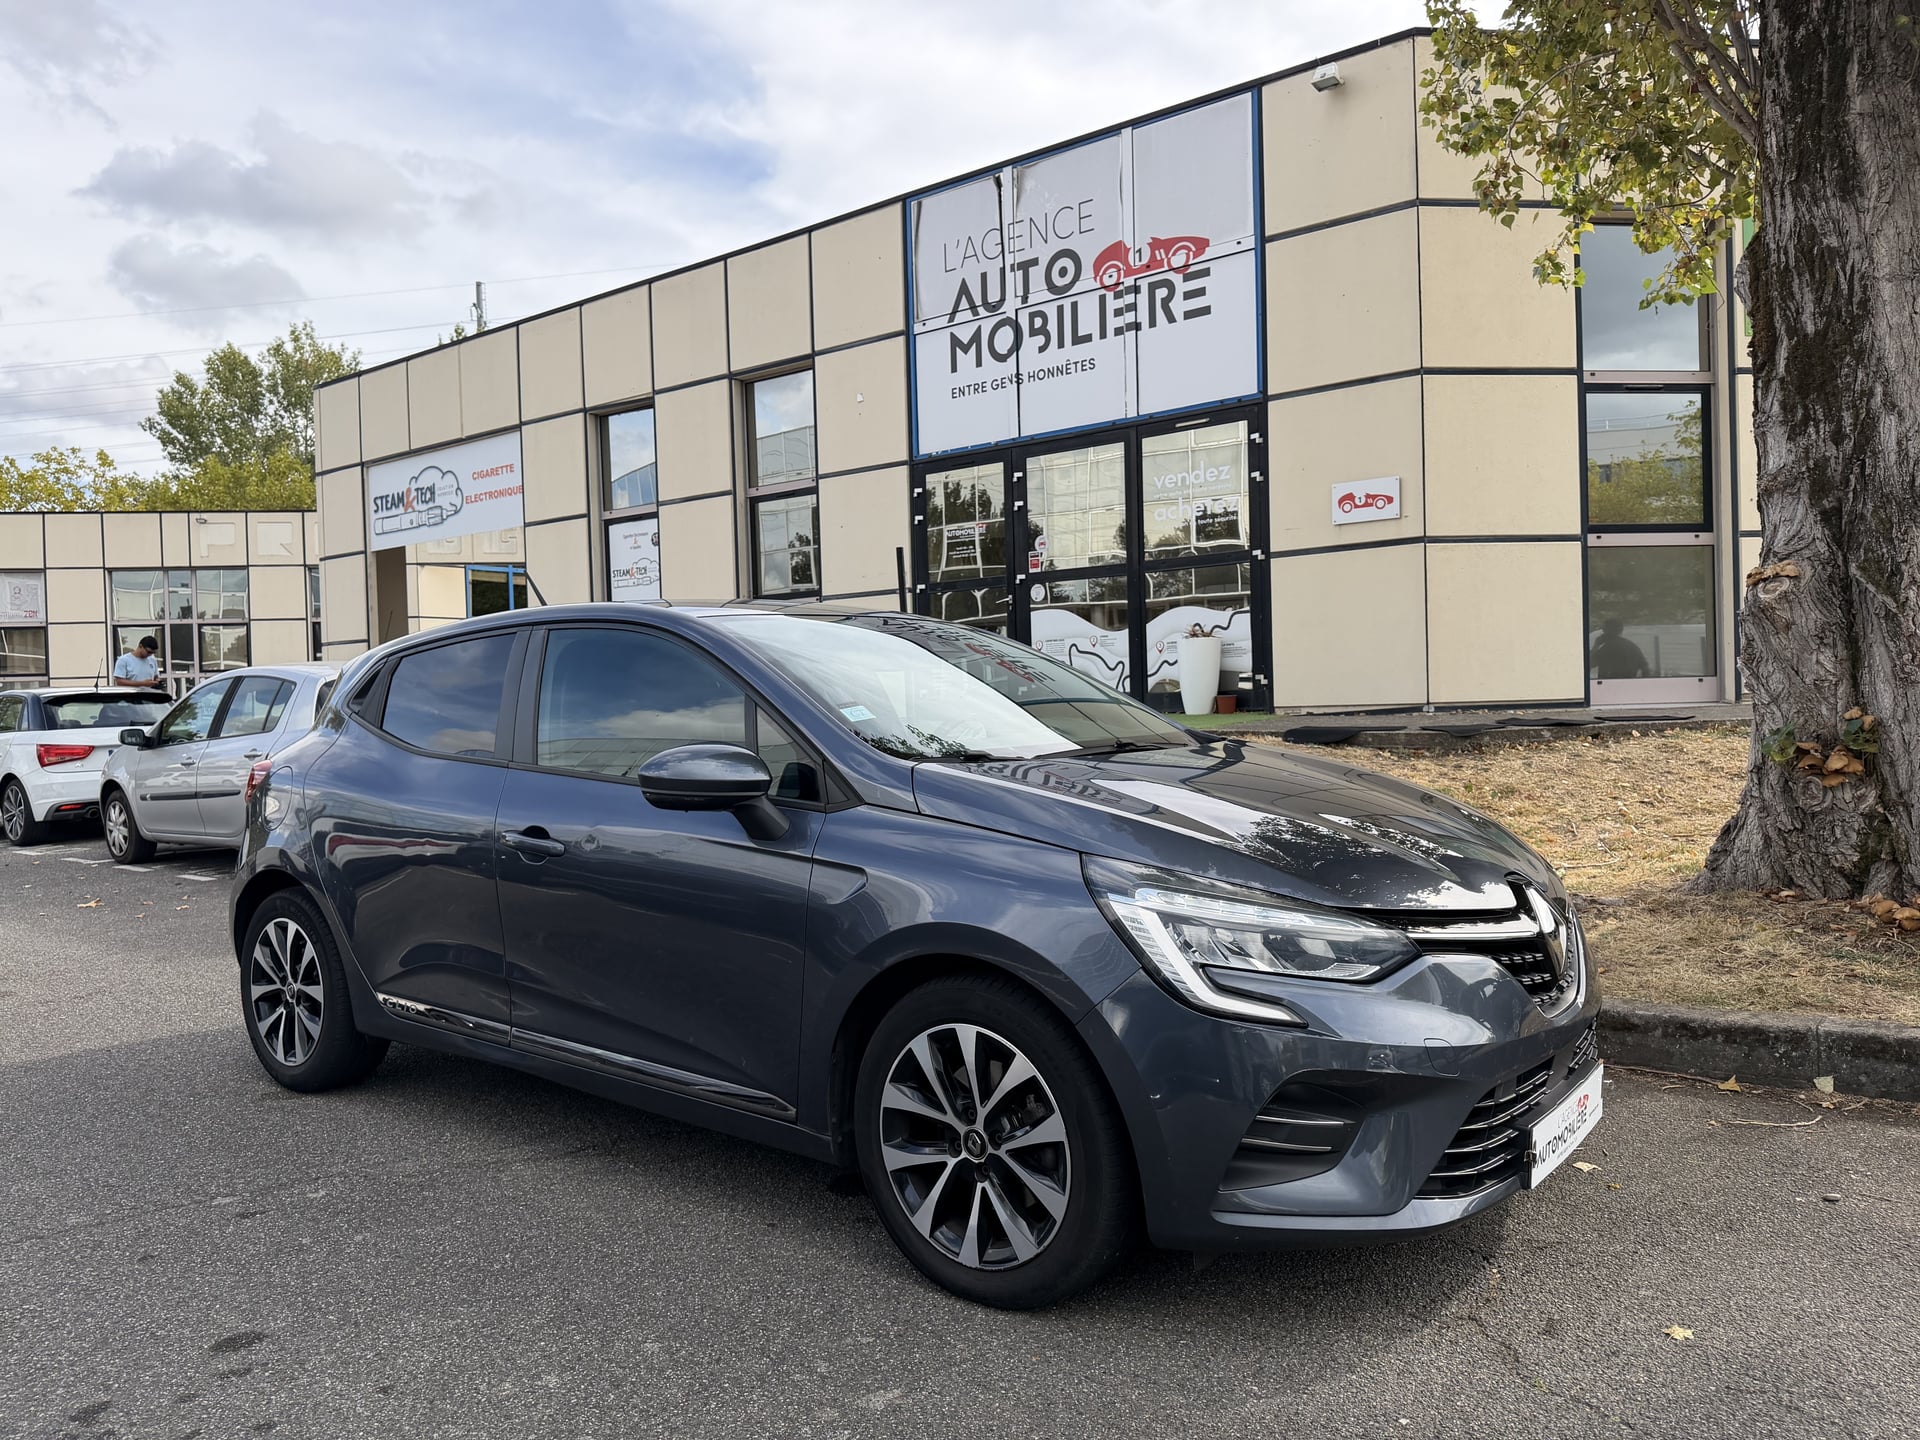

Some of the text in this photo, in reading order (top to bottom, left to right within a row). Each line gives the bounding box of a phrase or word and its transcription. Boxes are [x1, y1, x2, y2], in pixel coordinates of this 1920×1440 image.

[943, 199, 1095, 273] L'AGENCE
[947, 248, 1082, 324] AUTO
[951, 357, 1097, 399] ENTRE GENS HONNÊTES
[472, 463, 515, 481] CIGARETTE
[1154, 460, 1231, 489] vendez
[465, 484, 523, 505] ELECTRONIQUE
[1154, 496, 1238, 522] achetez
[386, 997, 418, 1014] CLIO
